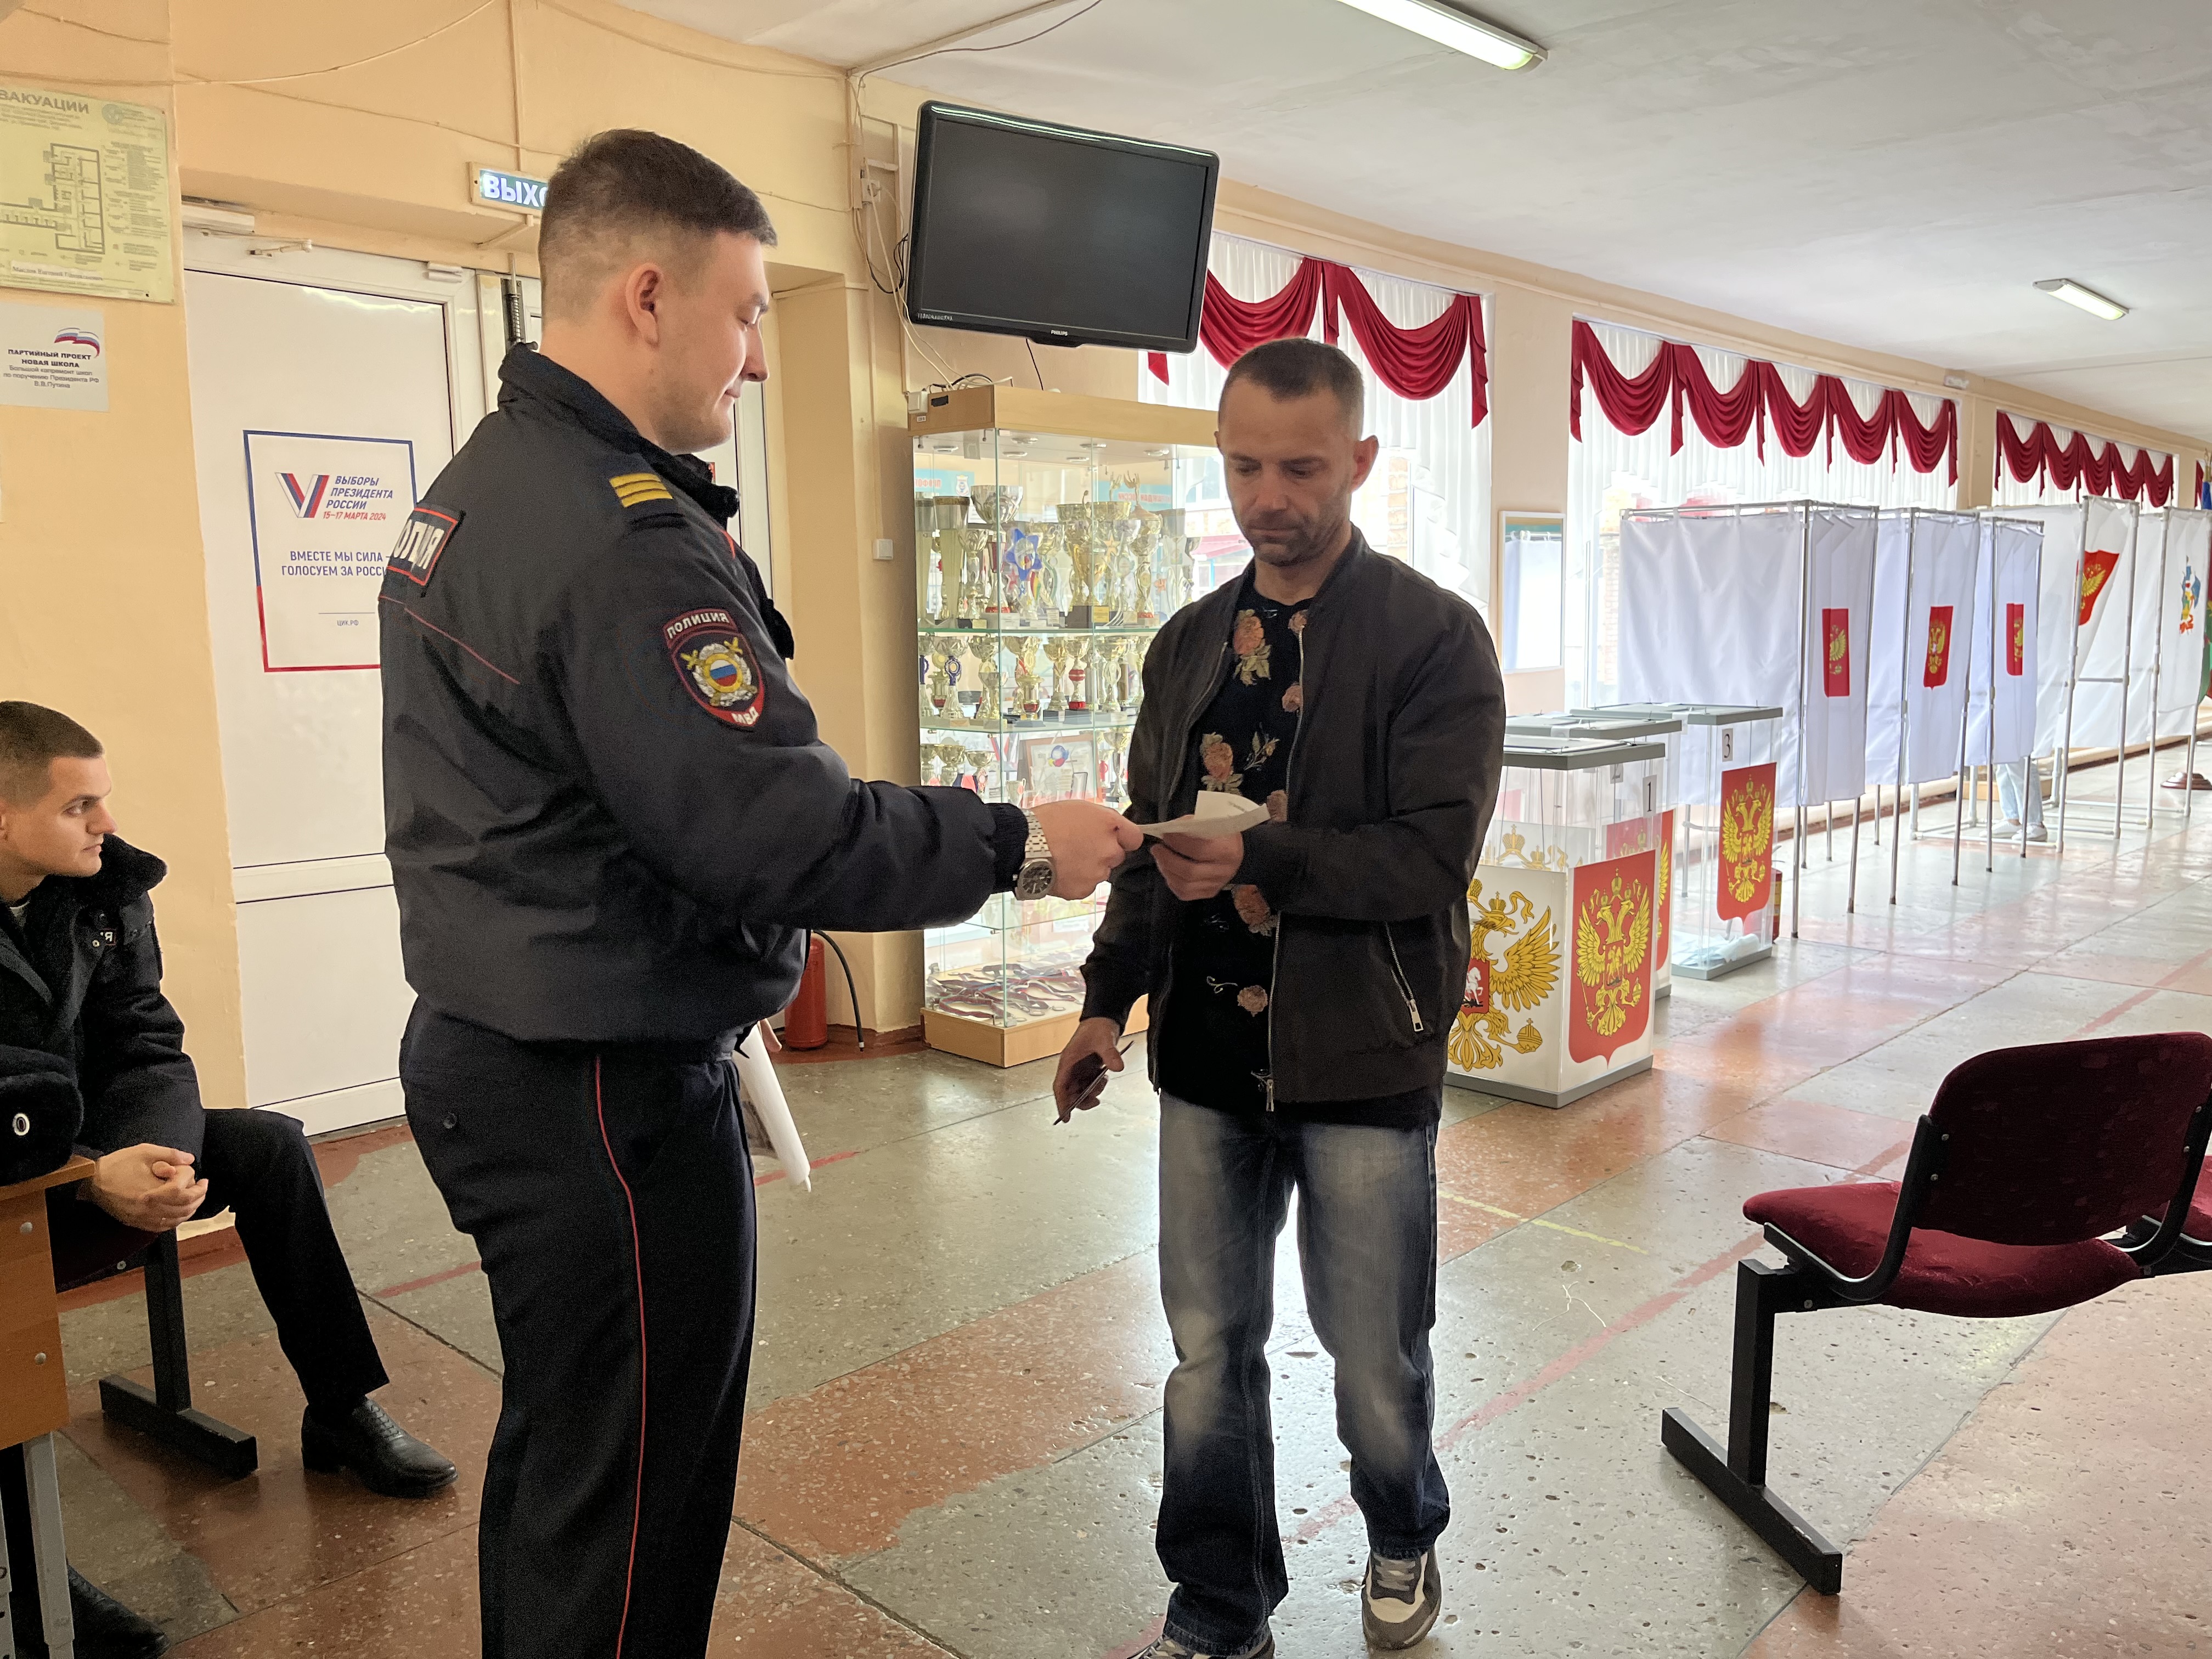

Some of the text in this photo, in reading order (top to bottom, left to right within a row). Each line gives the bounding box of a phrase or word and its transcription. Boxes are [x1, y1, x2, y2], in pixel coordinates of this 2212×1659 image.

[8, 348, 59, 358] ПАРТИЙНЫЙ
[50, 375, 88, 383] Президента
[335, 476, 380, 486] ВЫБОРЫ
[330, 488, 393, 499] ПРЕЗИДЕНТА
[326, 500, 368, 510] РОССИИ
[343, 512, 368, 521] МАРТА
[369, 512, 387, 521] 2024
[290, 551, 332, 561] ВМЕСТЕ
[335, 551, 353, 562] МЫ
[356, 552, 383, 562] СИЛА
[281, 566, 338, 576] ГОЛОСУЕМ
[340, 566, 353, 576] ЗА
[667, 612, 730, 639] ПОЛИЦИЯ
[731, 706, 759, 725] МВД
[1724, 733, 1731, 758] 3
[1647, 781, 1652, 812] 1
